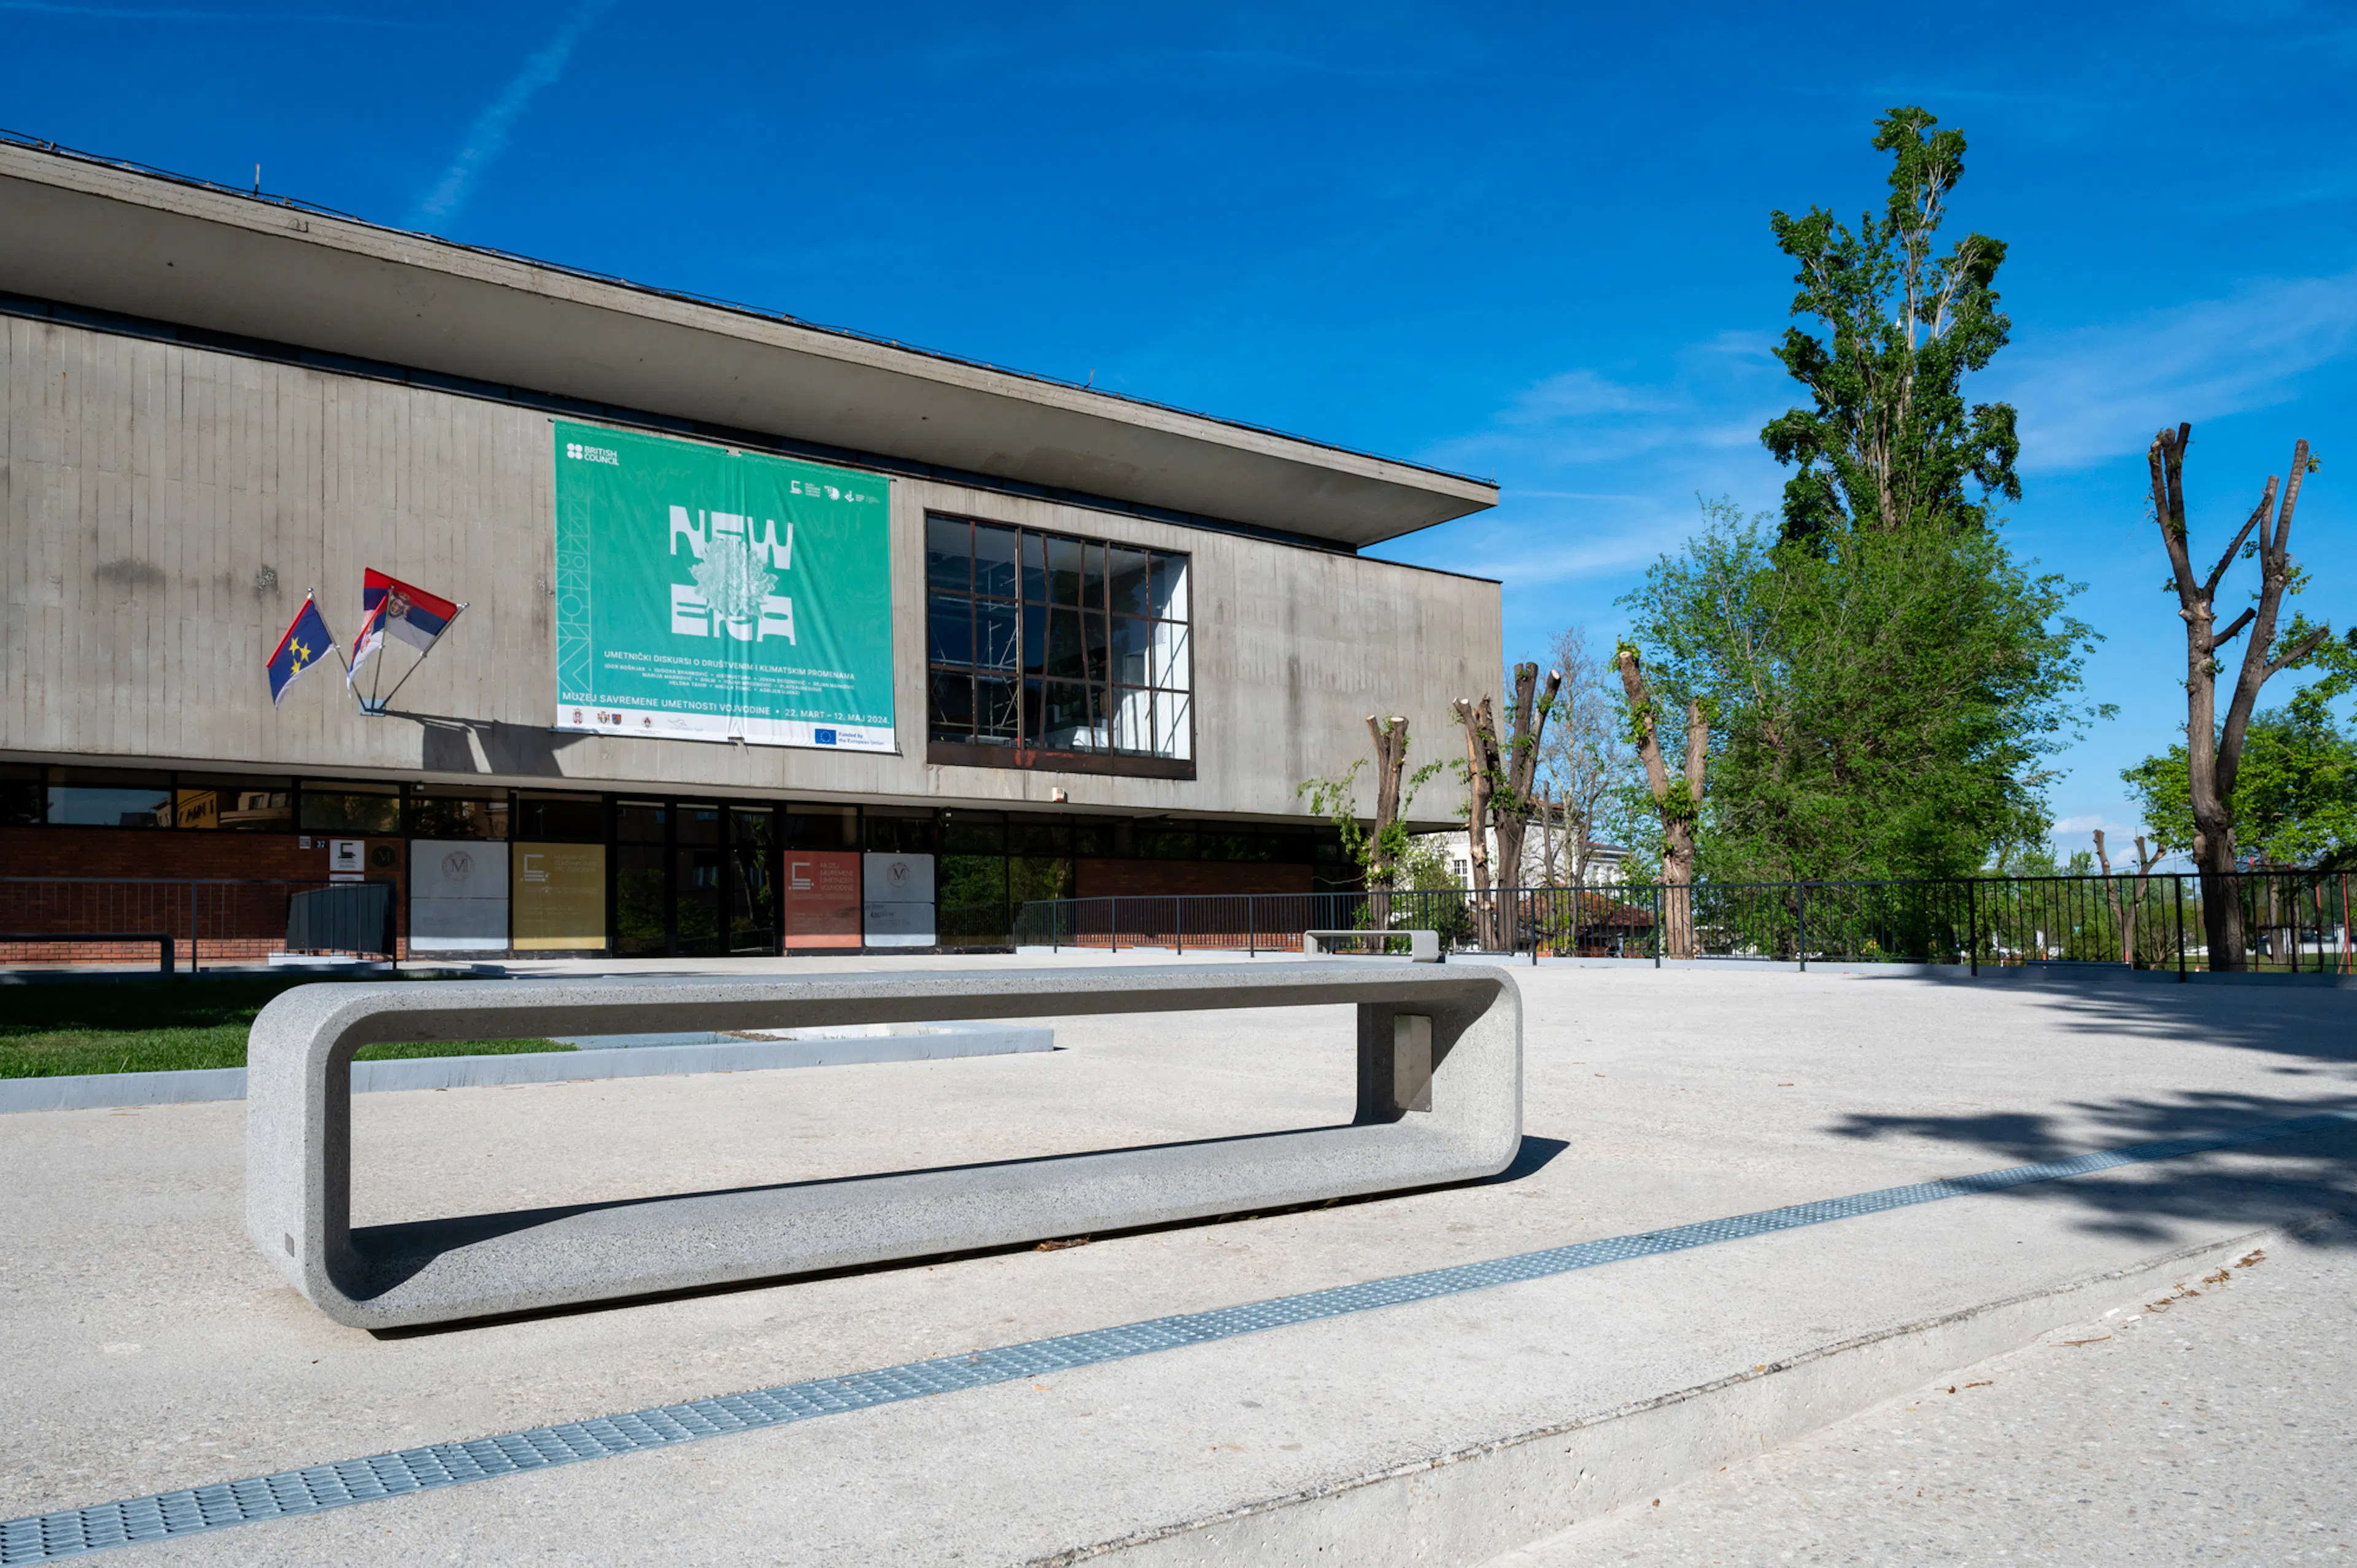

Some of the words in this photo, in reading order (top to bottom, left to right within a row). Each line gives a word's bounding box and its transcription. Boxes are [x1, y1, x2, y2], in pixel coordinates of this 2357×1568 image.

[584, 446, 617, 457] BRITISH
[584, 453, 619, 466] COUNCIL
[669, 504, 794, 570] NEW
[671, 583, 797, 646] ERA
[604, 651, 651, 662] UMETNIČKI
[653, 654, 691, 665] DISKURSI
[702, 659, 753, 670] DRUŠTVENIM
[759, 665, 806, 676] KLIMATSKIM
[807, 669, 855, 680] PROMENAMA
[562, 692, 597, 702] MUZEJ
[600, 695, 659, 707] SAVREMENE
[661, 699, 717, 711] UMETNOSTI
[719, 703, 770, 715] VOJVODINE
[785, 709, 798, 717] 22.
[800, 709, 825, 719] MART
[834, 713, 846, 721] 12.
[848, 714, 865, 722] MAJ
[867, 716, 890, 725] 2024.
